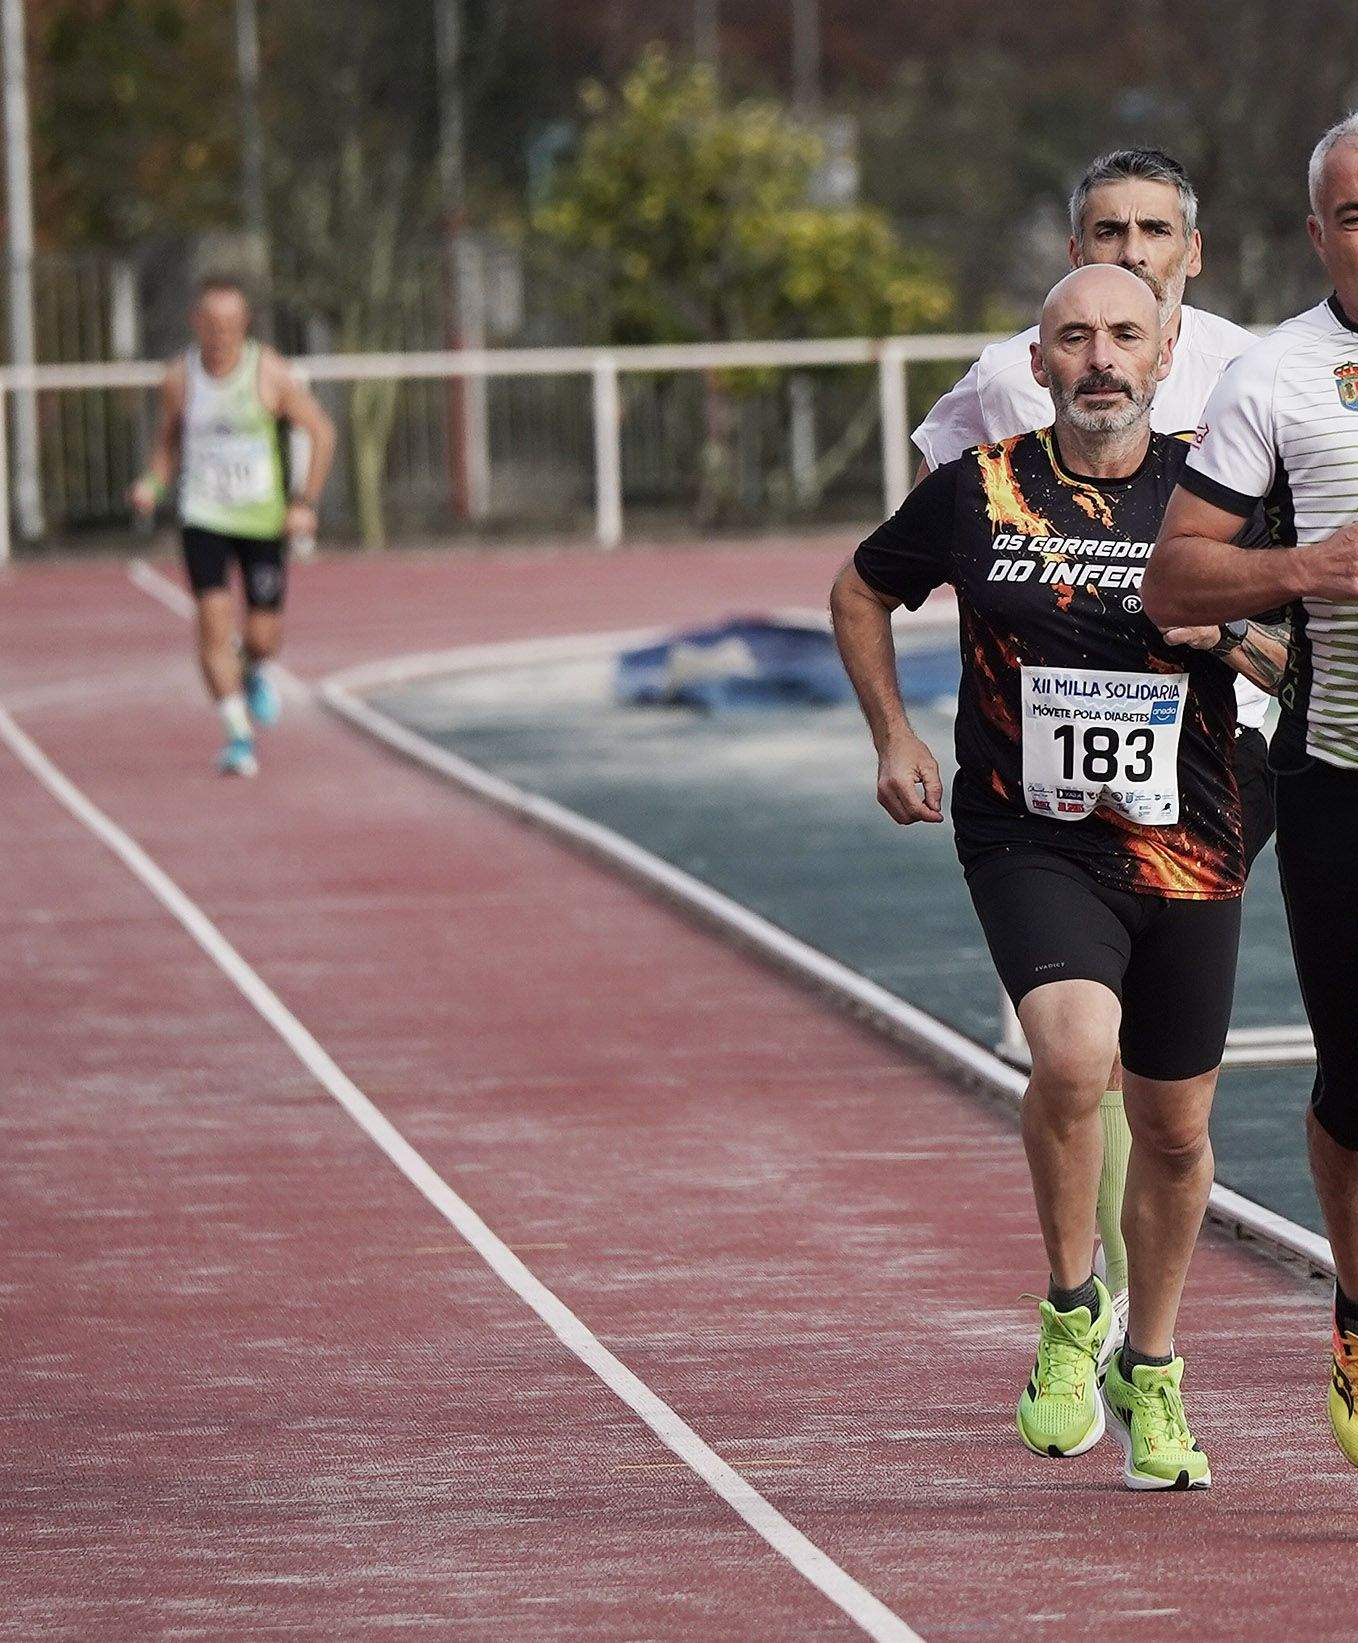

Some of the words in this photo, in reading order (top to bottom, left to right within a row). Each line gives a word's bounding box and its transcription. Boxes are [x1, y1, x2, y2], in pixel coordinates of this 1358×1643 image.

[992, 533, 1027, 551] OS
[987, 559, 1037, 583] DO
[1031, 677, 1051, 695] XII
[1055, 679, 1102, 698] MILLA
[1104, 681, 1180, 701] SOLIDARIA
[1032, 703, 1071, 719] MÓVETE
[1073, 709, 1102, 721] POLA
[1104, 711, 1150, 723] DIABETES
[1053, 724, 1155, 783] 183
